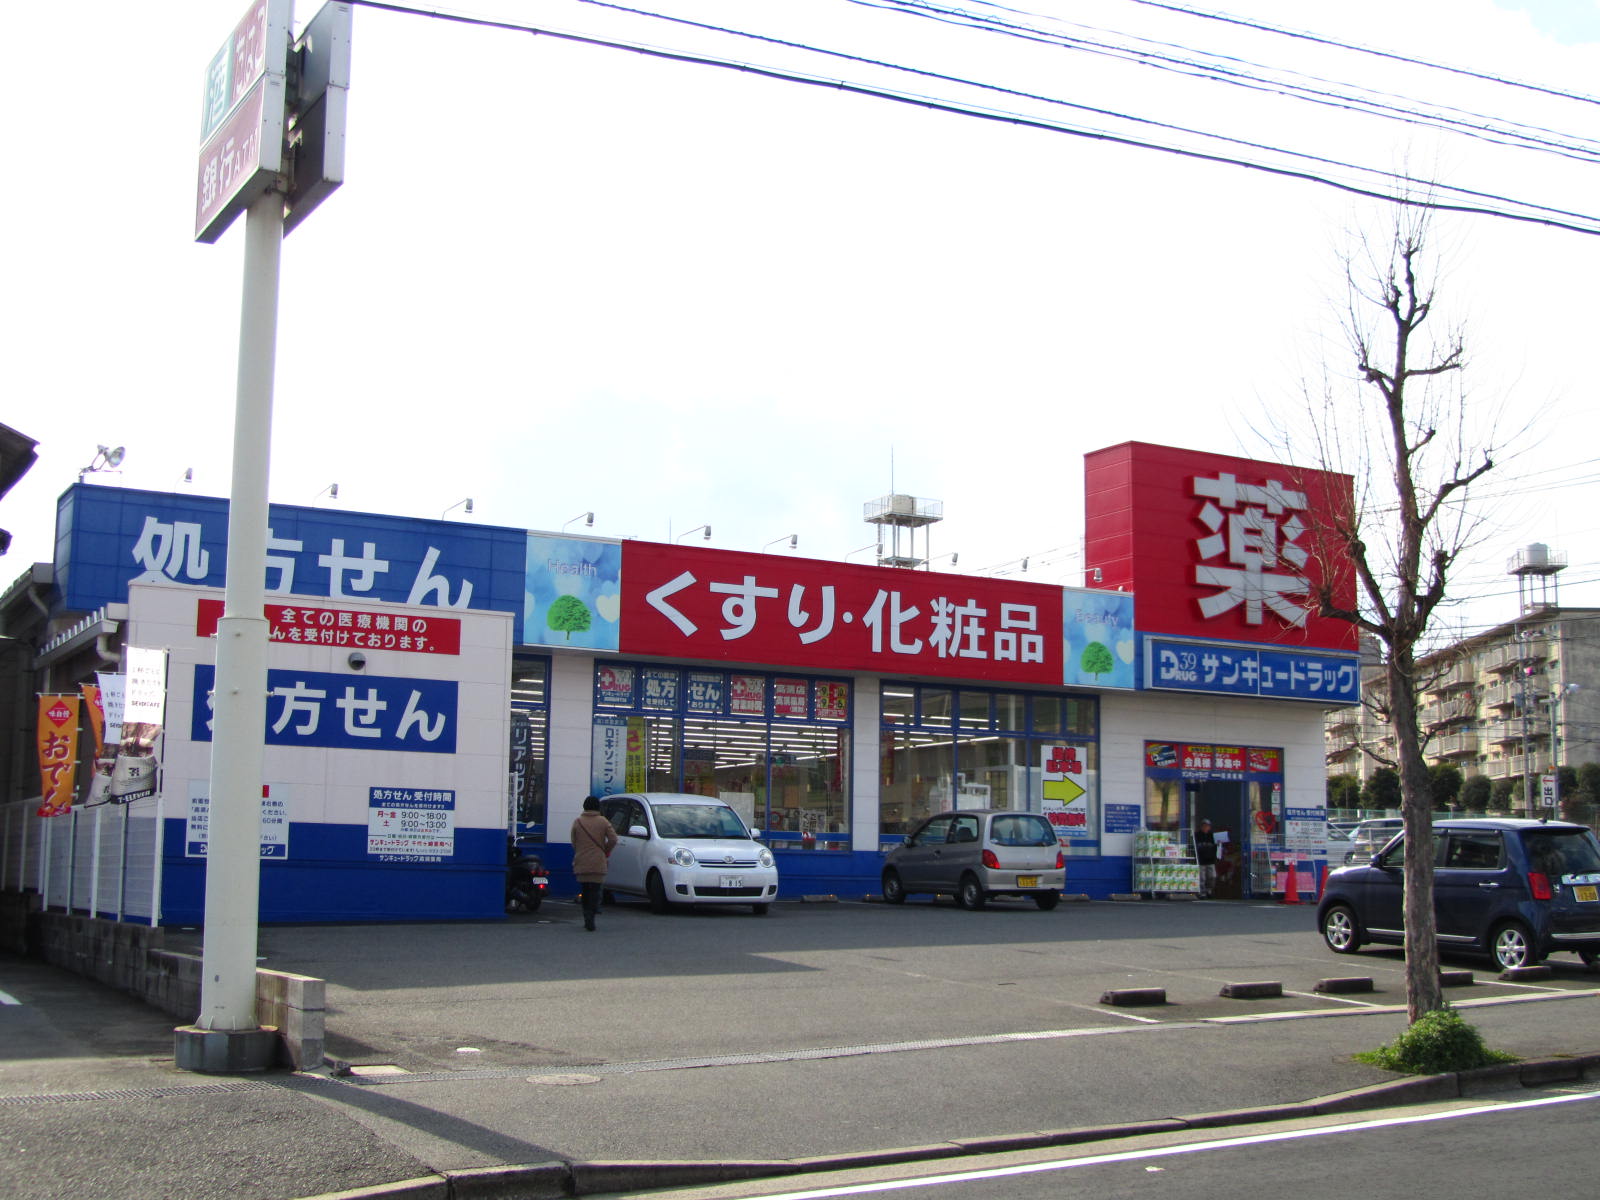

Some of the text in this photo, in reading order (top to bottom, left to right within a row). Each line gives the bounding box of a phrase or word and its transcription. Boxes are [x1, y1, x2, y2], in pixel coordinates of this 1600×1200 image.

[202, 136, 235, 214] 銀行
[1194, 472, 1310, 629] 薬
[547, 558, 598, 577] Health
[281, 608, 428, 634] 全ての医療機関の
[645, 570, 1044, 664] くすり・化粧品
[1075, 608, 1120, 627] Beauty
[1202, 653, 1357, 694] サンキュードラッグ
[646, 679, 676, 698] 処方
[691, 682, 720, 701] せん
[206, 681, 447, 742] 方せん
[373, 789, 452, 802] 処方せん 受付時間
